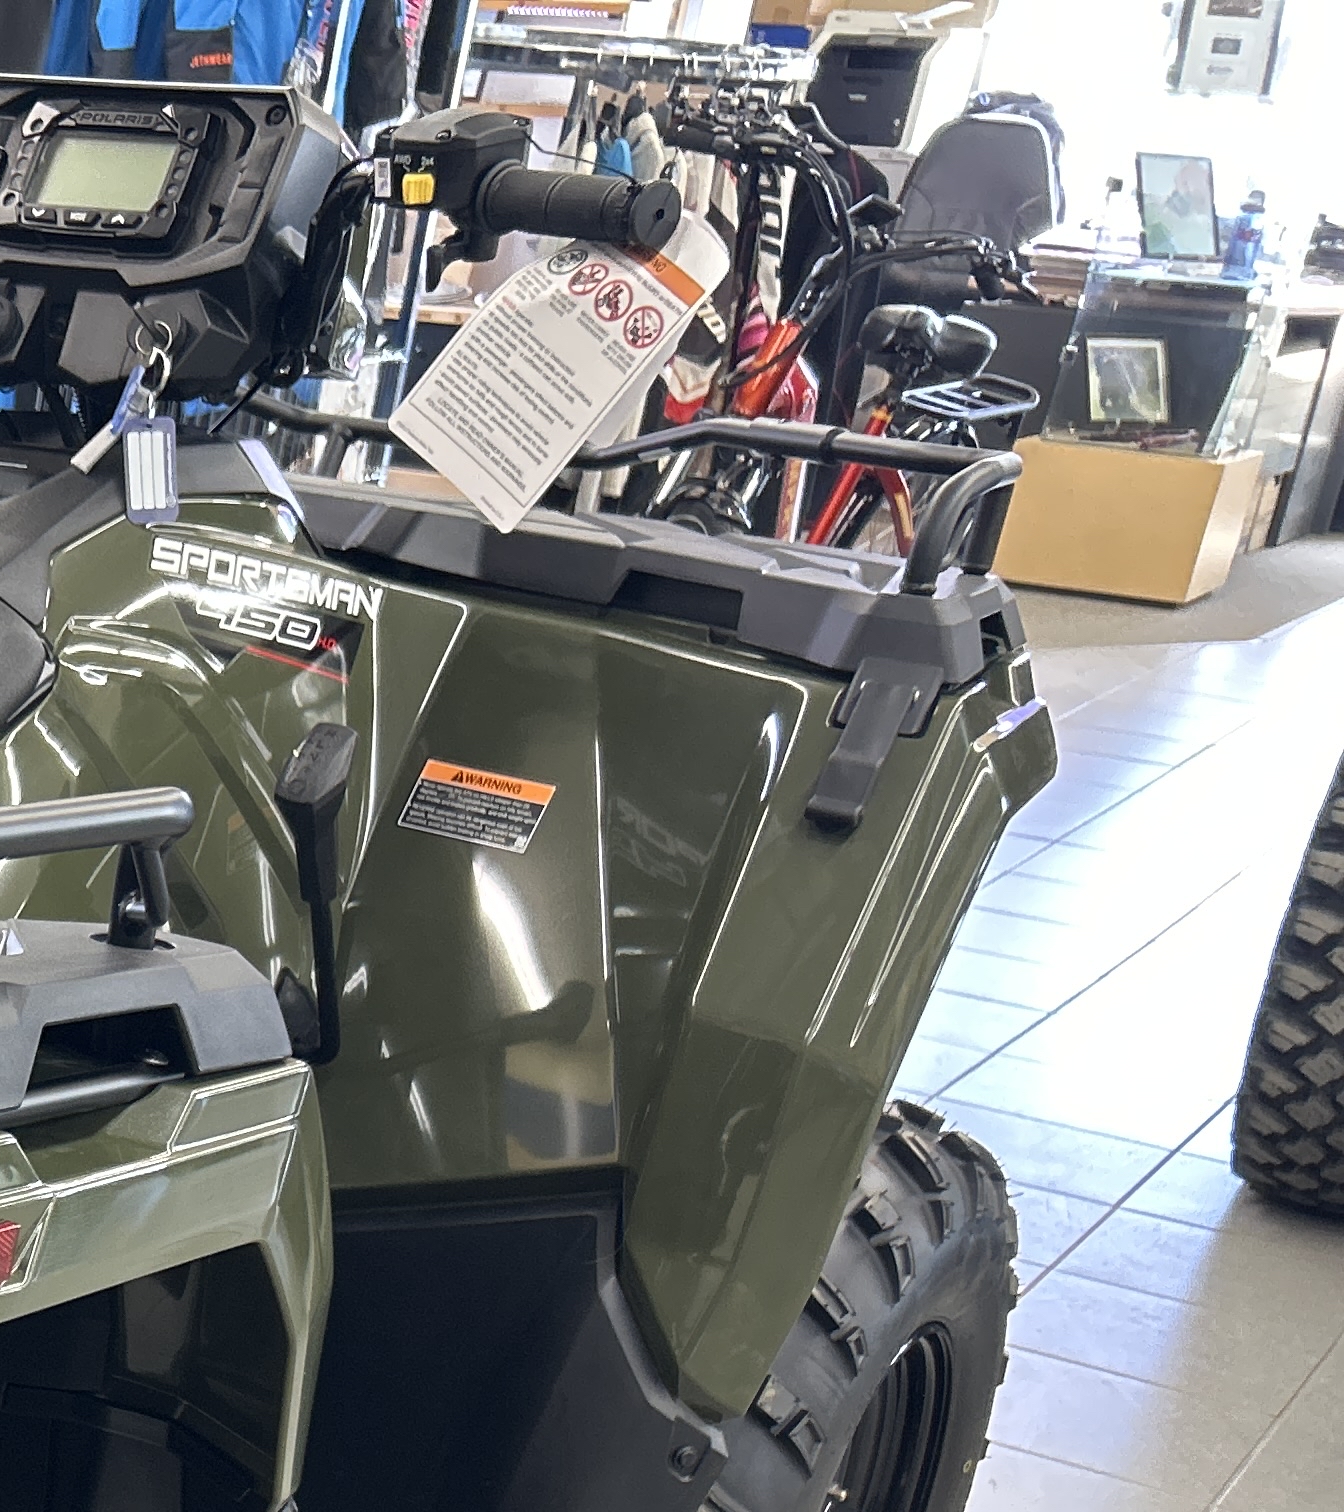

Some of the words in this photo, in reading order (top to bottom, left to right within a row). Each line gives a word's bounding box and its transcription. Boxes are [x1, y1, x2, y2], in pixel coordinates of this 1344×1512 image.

[80, 111, 155, 127] POLARIS
[151, 537, 383, 621] SPORTSMAN
[196, 597, 321, 651] 450
[464, 772, 524, 797] WARNING
